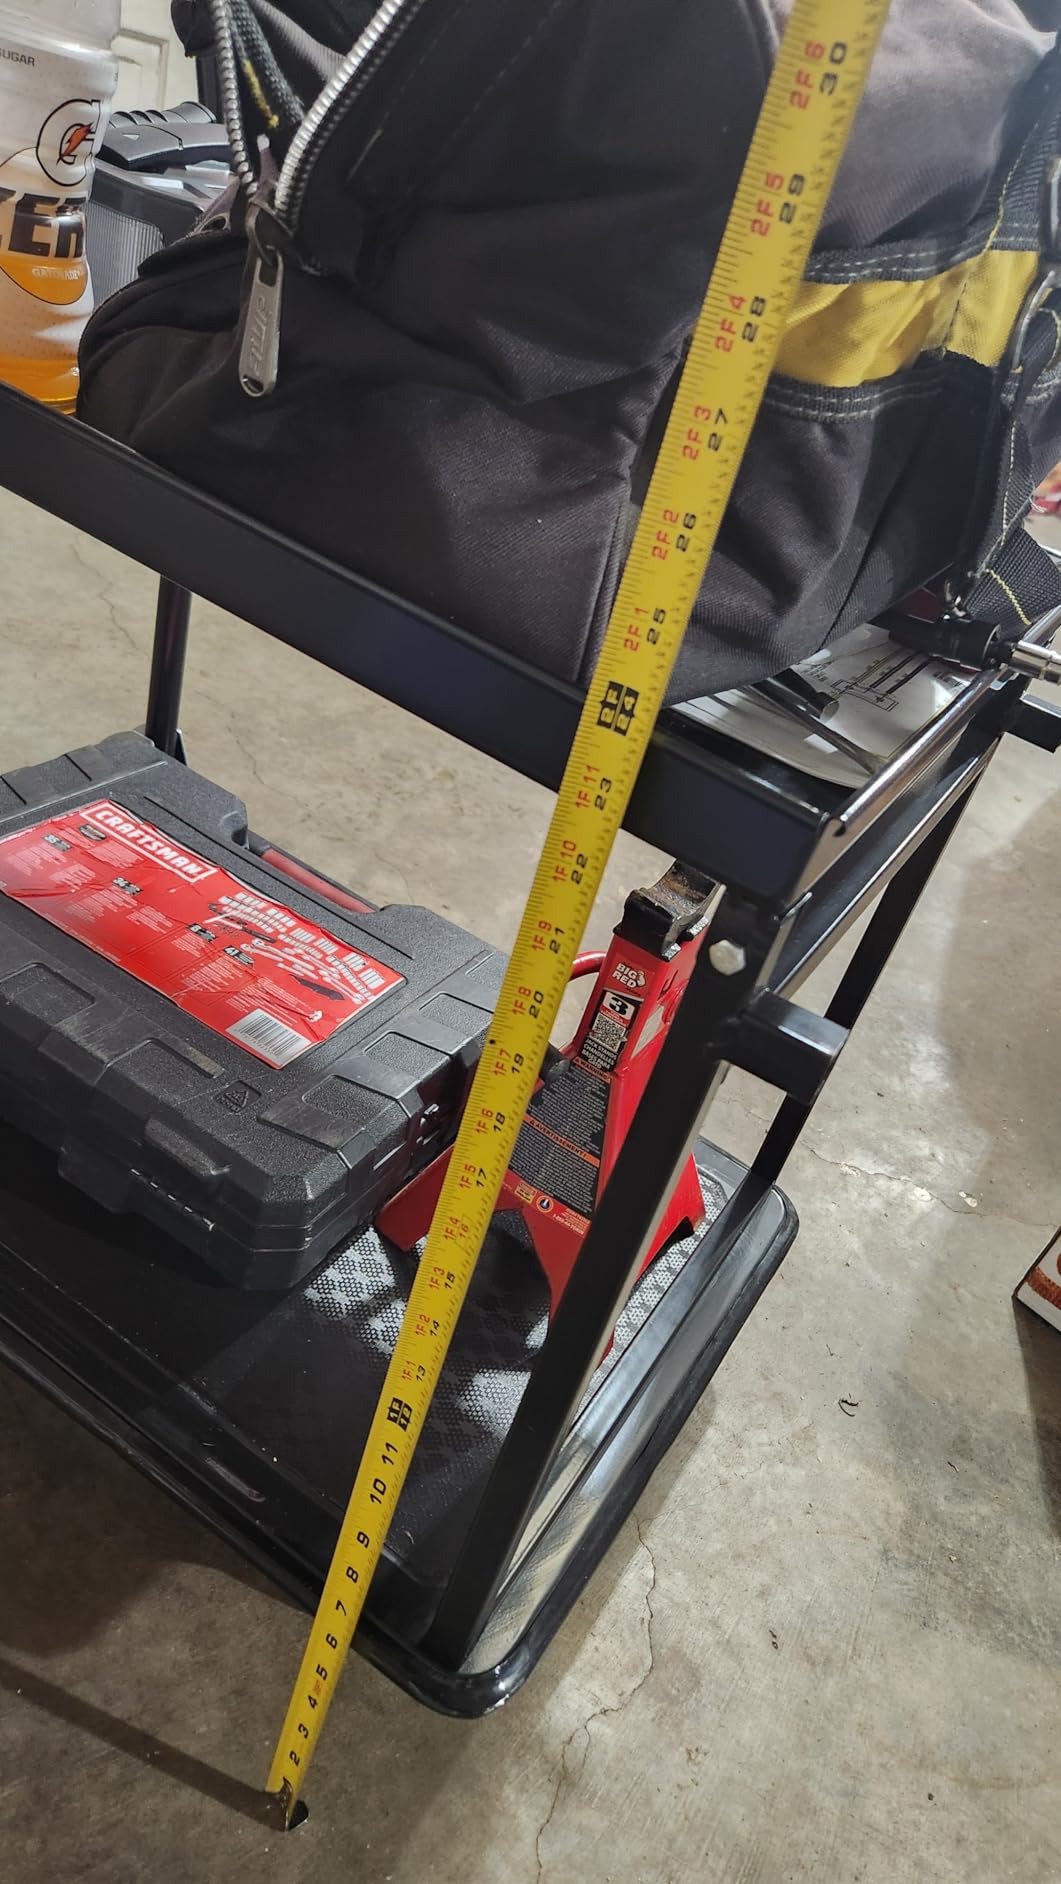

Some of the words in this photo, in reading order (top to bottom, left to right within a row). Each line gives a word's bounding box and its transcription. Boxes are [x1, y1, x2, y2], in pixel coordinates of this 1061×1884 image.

[0, 48, 35, 67] UGAR
[789, 69, 814, 109] 2F
[805, 41, 826, 59] 6
[820, 42, 848, 95] 30
[751, 200, 774, 236] 2F
[765, 172, 784, 189] 5
[779, 174, 805, 224] 29
[715, 319, 736, 352] 2F
[729, 294, 747, 310] 4
[742, 296, 766, 342] 28
[683, 428, 703, 460] 2F
[694, 406, 711, 420] 3
[708, 408, 728, 452] 27
[652, 530, 671, 560] 2F
[663, 509, 679, 523] 2
[676, 512, 697, 552] 26
[624, 624, 641, 652] 2F
[634, 607, 649, 616] 1
[647, 608, 666, 645] 25
[616, 694, 635, 730] 24
[575, 791, 591, 809] 1F
[584, 765, 600, 783] 11
[595, 777, 612, 811] 23
[95, 810, 203, 877] CRAFTSMAN
[552, 865, 567, 882] 1F
[560, 840, 577, 858] 10
[571, 853, 588, 885] 22
[539, 920, 552, 931] 9
[532, 934, 547, 952] 1F
[549, 927, 565, 954] 21
[612, 970, 638, 989] RED
[616, 962, 637, 980] BIG
[518, 986, 531, 997] 8
[512, 999, 526, 1016] 1F
[529, 990, 545, 1019] 20
[608, 996, 629, 1016] 3
[499, 1048, 512, 1060] 7
[494, 1061, 508, 1076] 1F
[511, 1053, 525, 1074] 19
[481, 1108, 494, 1119] 6
[493, 1112, 506, 1133] 18
[476, 1119, 488, 1135] 1F
[464, 1164, 477, 1174] 5
[476, 1168, 488, 1188] 17
[460, 1174, 473, 1189] 1F
[449, 1217, 460, 1226] 4
[443, 1225, 456, 1240] 1F
[459, 1224, 470, 1240] 16
[434, 1266, 446, 1276] 3
[429, 1275, 441, 1290] 1F
[444, 1272, 456, 1289] 15
[419, 1314, 431, 1323] 2
[415, 1322, 428, 1337] 1F
[429, 1320, 441, 1337] 14
[406, 1360, 417, 1368] 1
[416, 1364, 427, 1382] 13
[401, 1367, 413, 1382] 1F
[399, 1407, 412, 1429] 12
[382, 1442, 399, 1466] 11
[370, 1478, 387, 1505] 10
[357, 1531, 370, 1548] 9
[346, 1566, 359, 1584] 8
[336, 1600, 347, 1616] 7
[326, 1633, 338, 1649] 6
[316, 1664, 328, 1681] 5
[308, 1694, 319, 1709] 4
[298, 1723, 310, 1739] 3
[289, 1750, 301, 1766] 2
